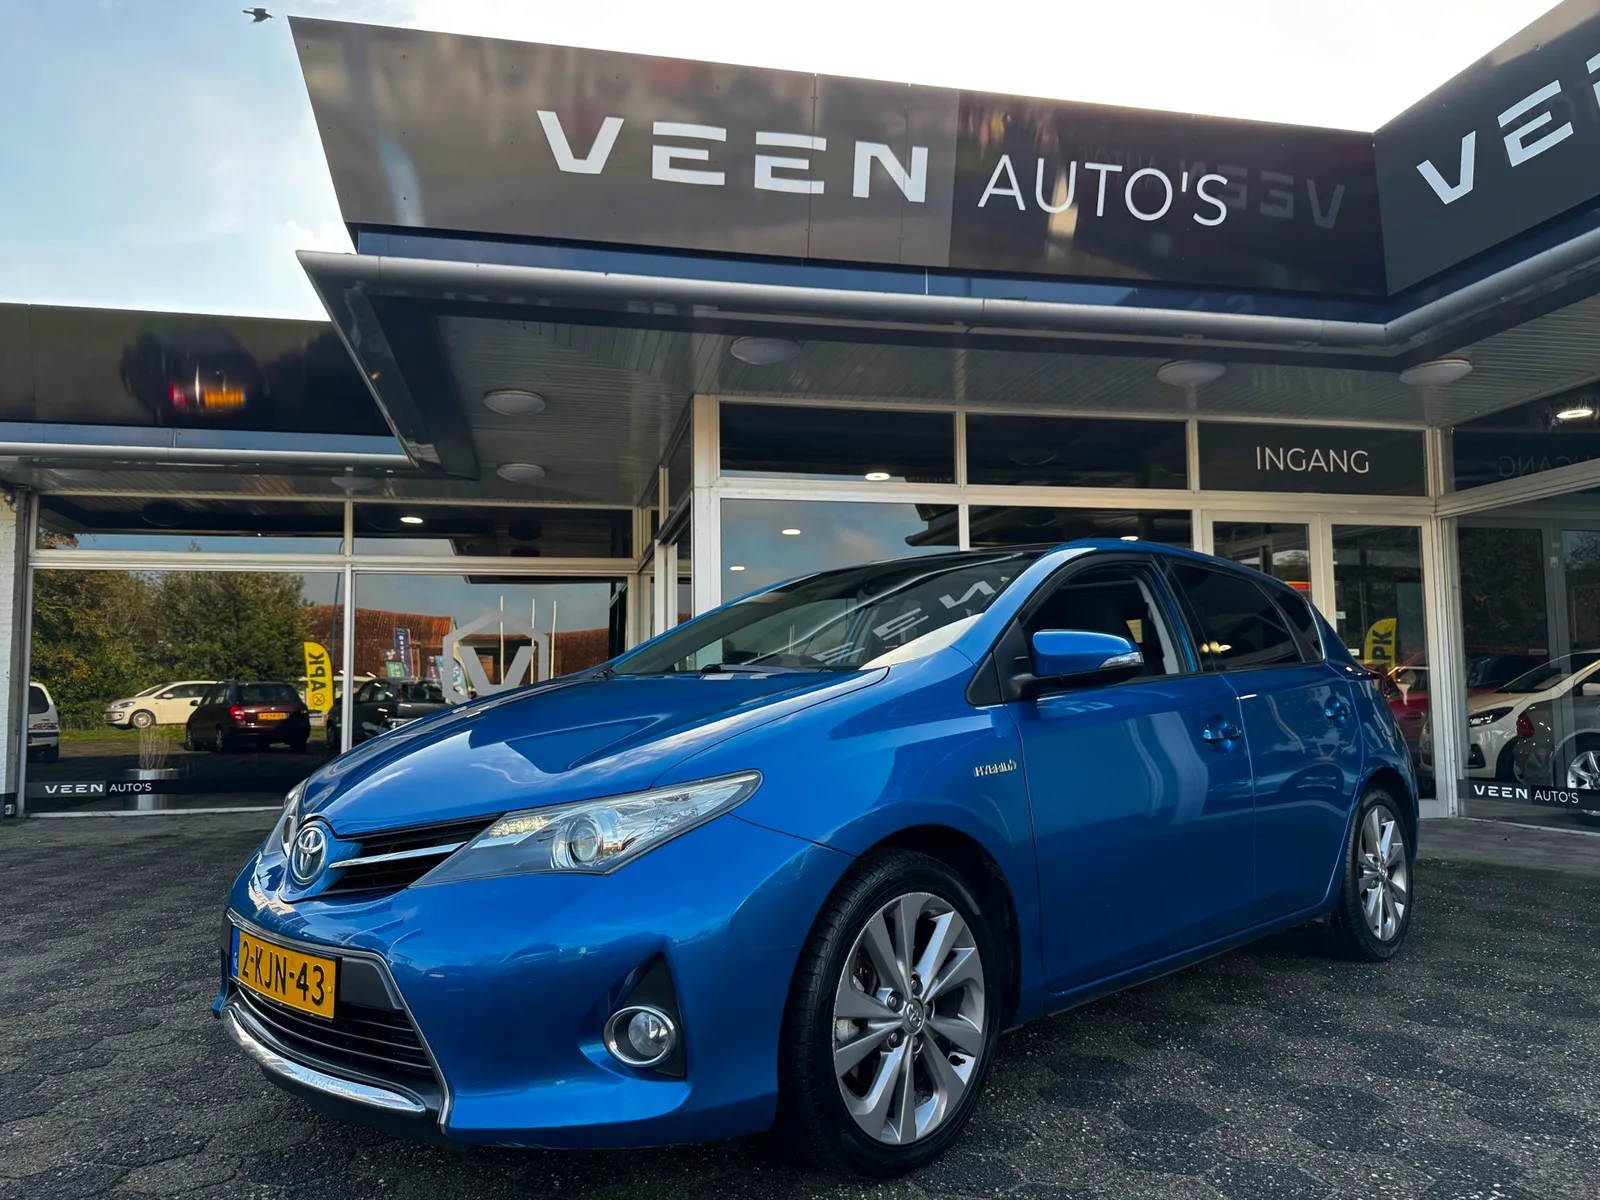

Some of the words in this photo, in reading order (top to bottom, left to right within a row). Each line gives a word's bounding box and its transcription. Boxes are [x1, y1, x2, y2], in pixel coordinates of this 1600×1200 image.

[1416, 53, 1600, 205] VE
[536, 109, 929, 203] VEEN
[977, 153, 1229, 226] AUTO'S
[1255, 445, 1370, 474] INGANG
[1371, 630, 1393, 664] PK
[44, 784, 104, 794] VEEN
[109, 782, 152, 792] AUTO'S
[1473, 784, 1528, 799] VEEN
[1534, 790, 1579, 804] AUTO'S
[242, 940, 325, 1007] 2-KJN-43
